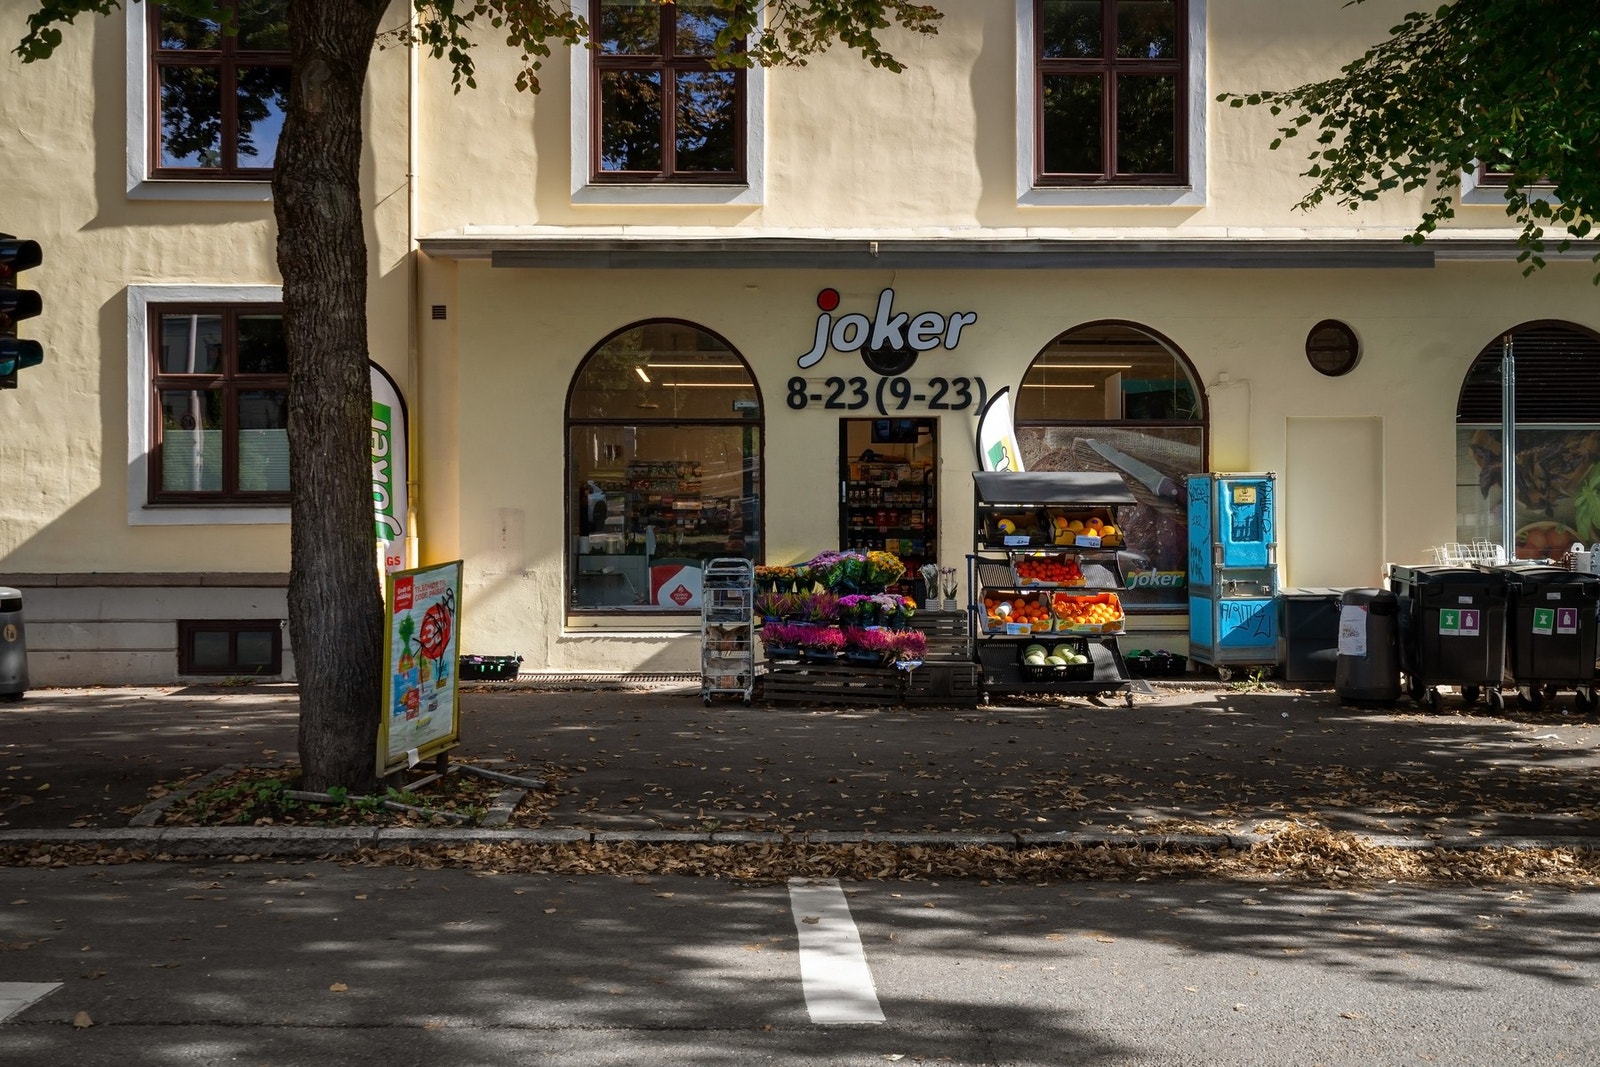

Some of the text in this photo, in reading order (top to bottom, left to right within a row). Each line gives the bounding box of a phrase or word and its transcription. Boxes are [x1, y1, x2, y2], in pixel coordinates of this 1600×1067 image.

[797, 287, 978, 369] joker
[786, 376, 988, 416] 8-23 (9-23)
[1128, 567, 1181, 591] joker
